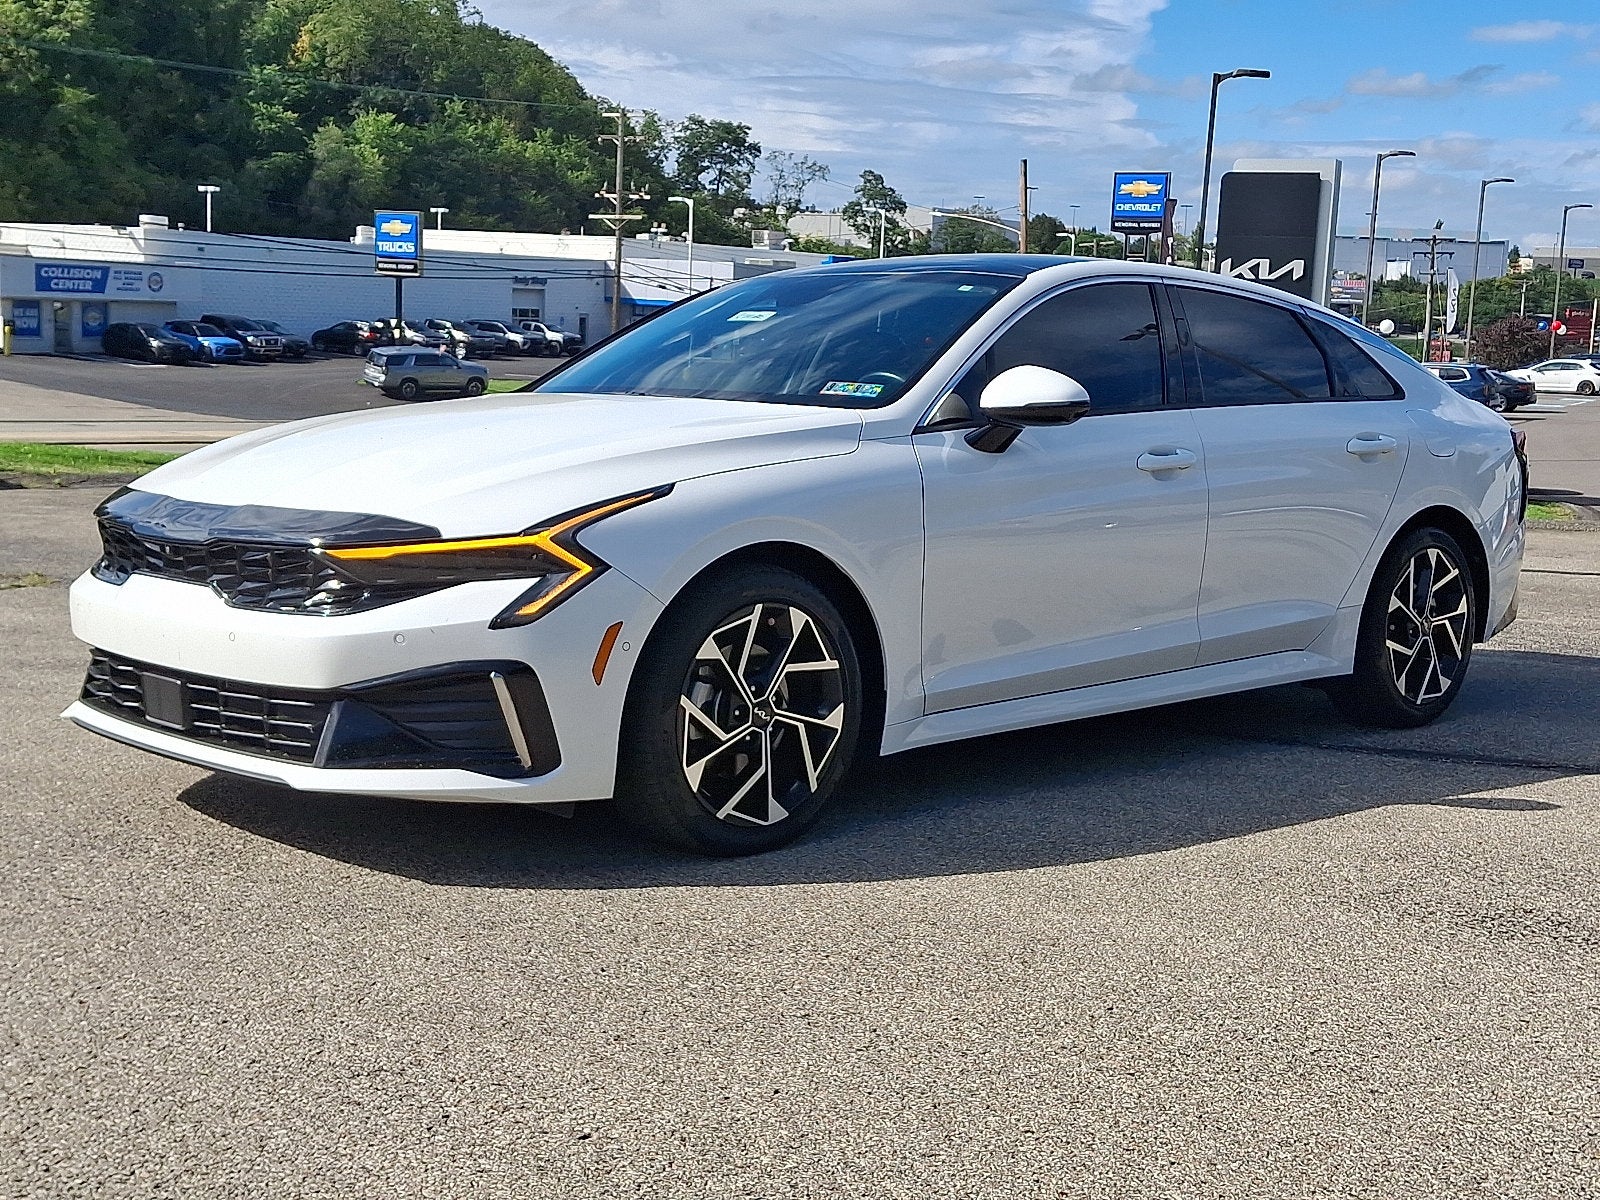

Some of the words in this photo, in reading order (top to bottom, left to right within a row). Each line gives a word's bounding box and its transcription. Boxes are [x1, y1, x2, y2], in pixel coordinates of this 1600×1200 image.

[1116, 203, 1162, 212] CHEVROLET
[377, 241, 416, 253] TRUCKS
[40, 266, 103, 280] COLLISION
[1220, 257, 1305, 281] KIA
[50, 278, 93, 291] CENTER
